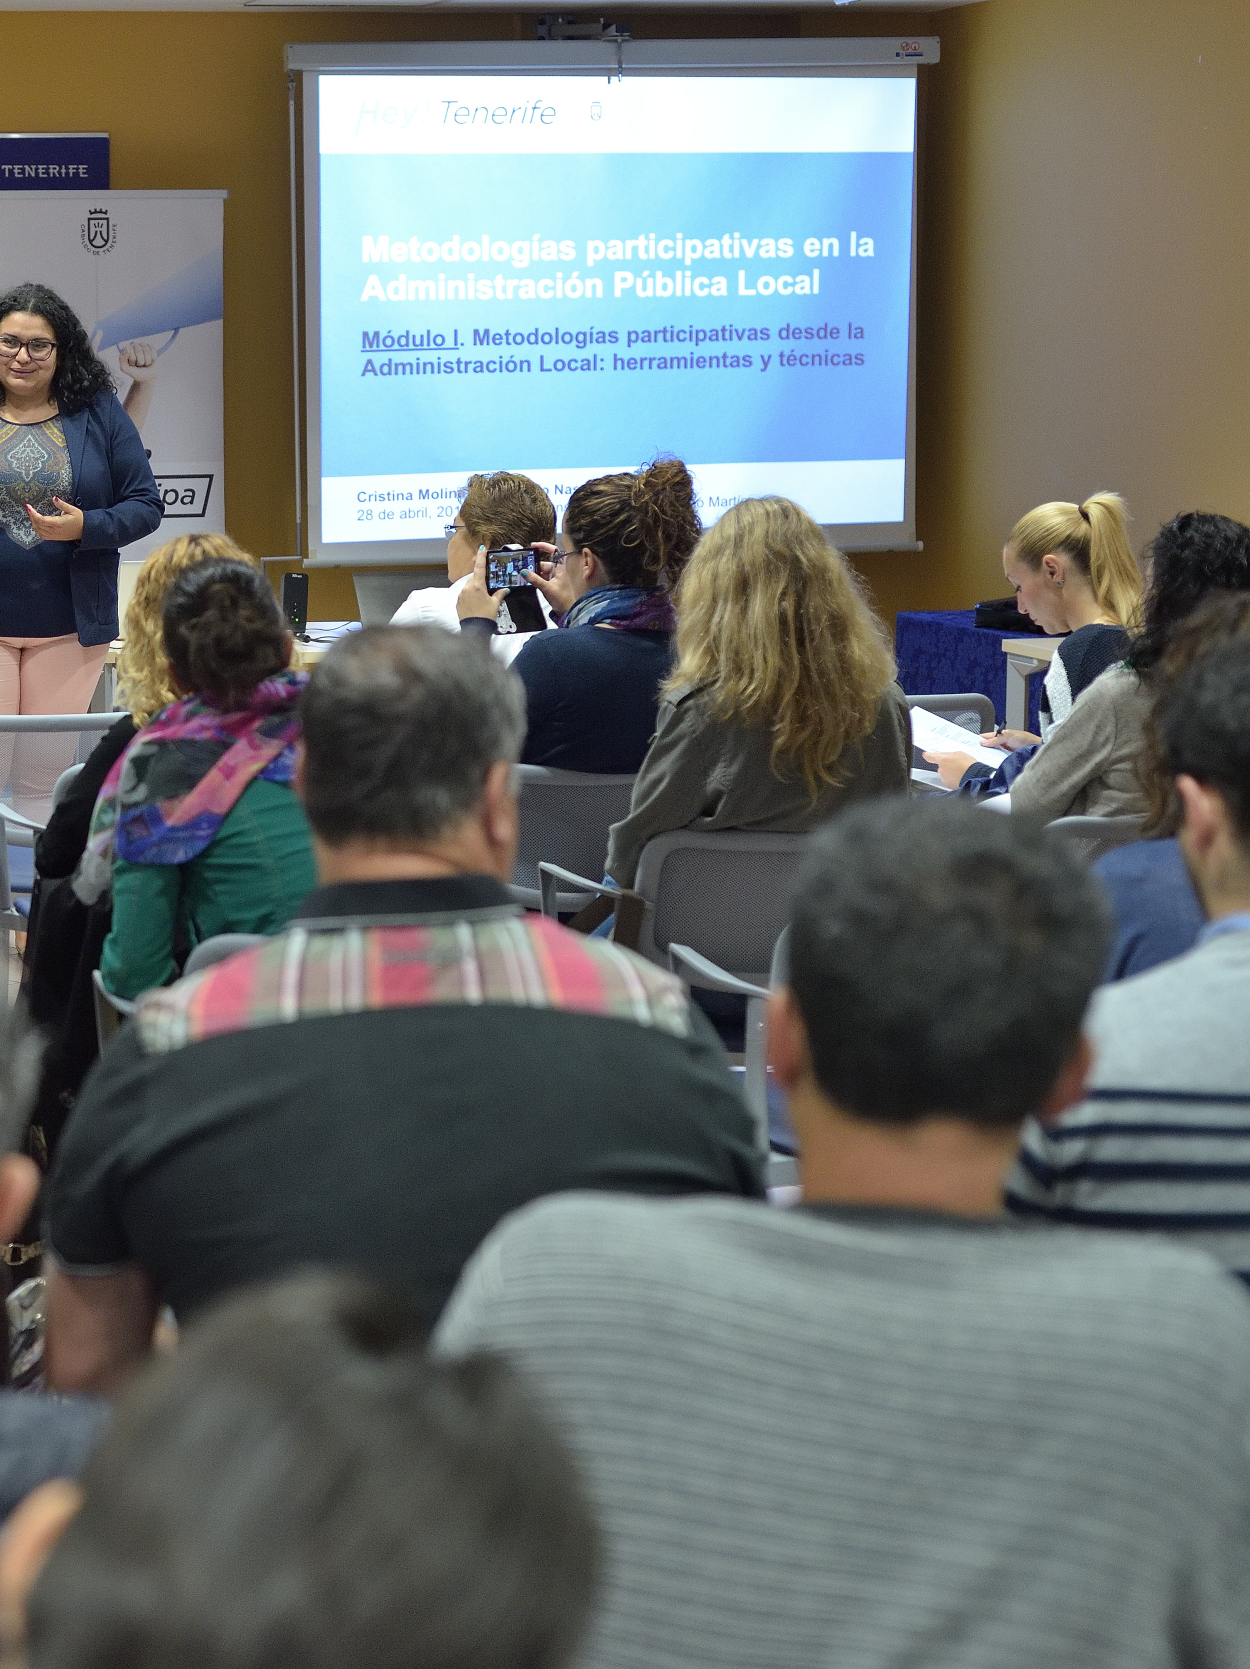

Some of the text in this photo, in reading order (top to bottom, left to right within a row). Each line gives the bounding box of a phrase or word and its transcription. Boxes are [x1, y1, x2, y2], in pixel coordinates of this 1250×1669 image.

[441, 100, 556, 125] Tenerife
[1, 164, 88, 178] TENERIFE
[362, 231, 875, 268] Metodologías participativas en la
[360, 269, 820, 301] Administración Pública Local
[361, 322, 865, 349] Módulo I. Metodologías participativas desde la
[361, 349, 865, 377] Administración Local: herramientas y técnicas
[357, 489, 413, 503] Cristina
[418, 488, 458, 500] Molin
[357, 510, 373, 521] 28
[378, 508, 395, 520] de
[399, 506, 432, 520] abril,
[437, 505, 460, 518] 201
